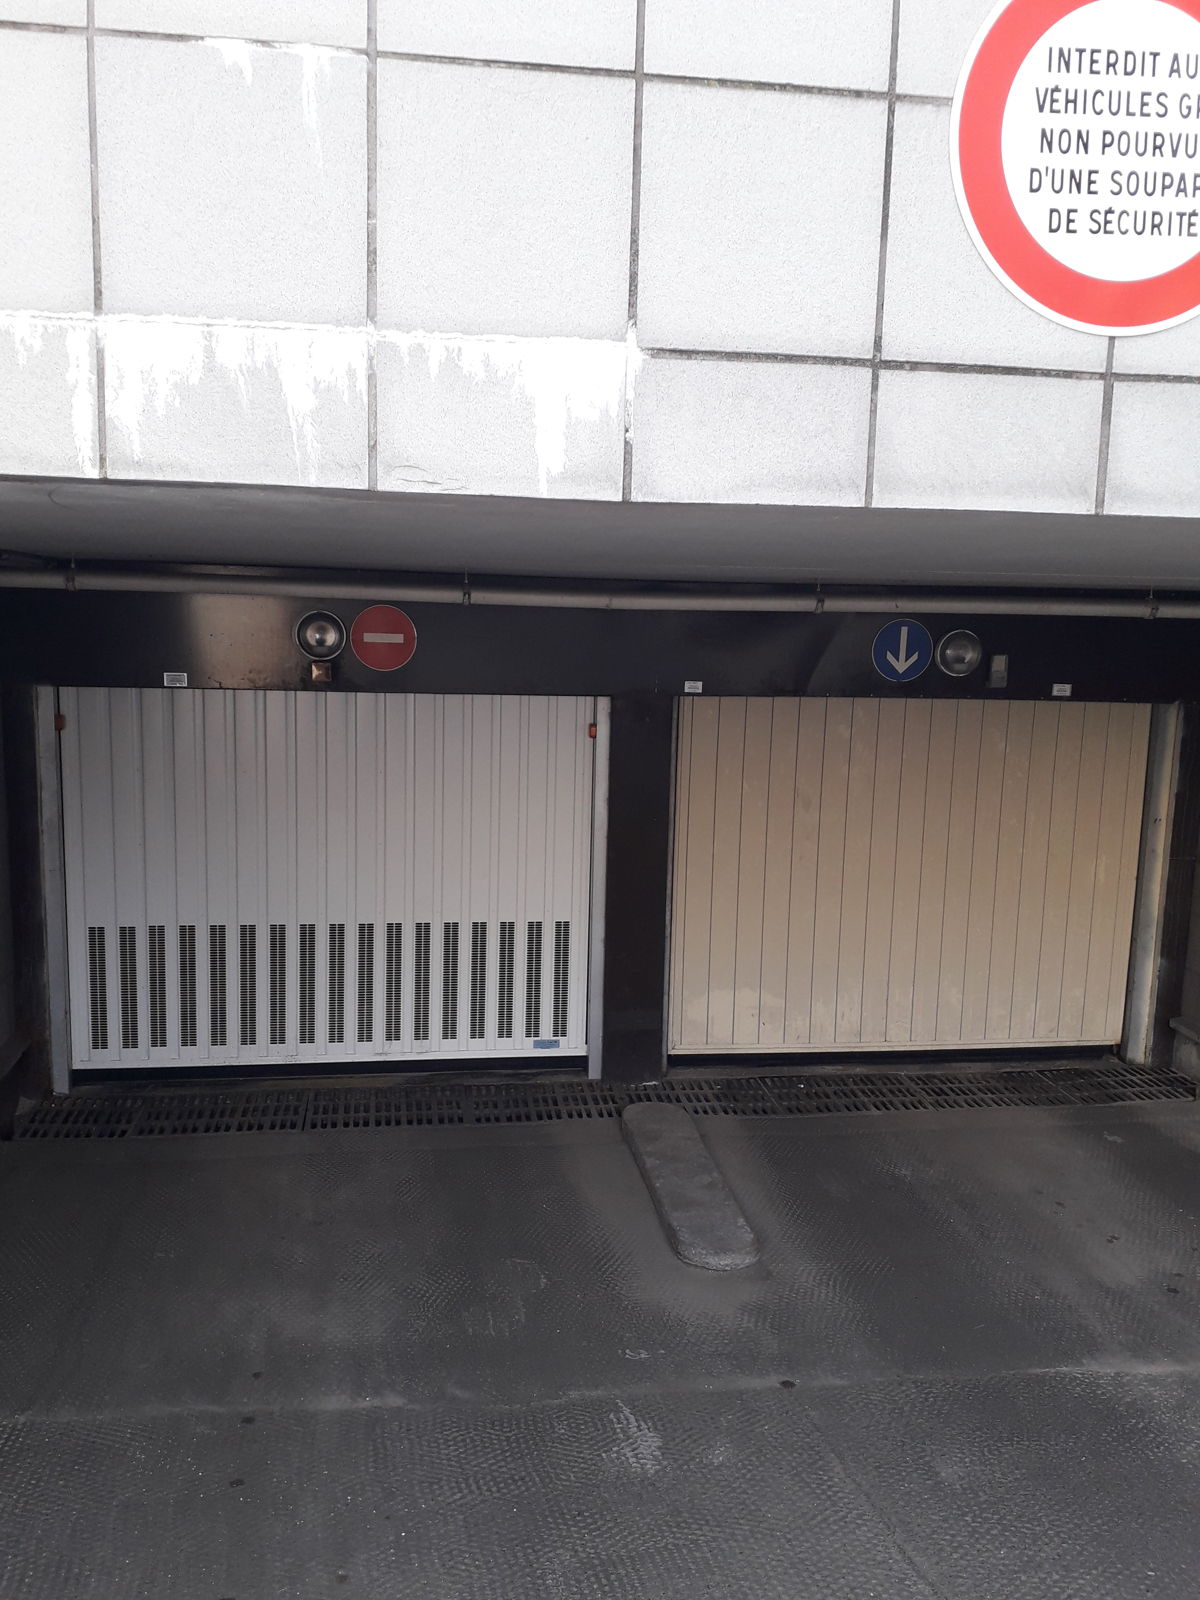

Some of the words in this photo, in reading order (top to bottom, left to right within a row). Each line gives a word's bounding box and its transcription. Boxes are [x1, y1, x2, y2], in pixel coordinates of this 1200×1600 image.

[1049, 47, 1160, 77] INTERDIT
[1036, 85, 1168, 118] VÉHICULES
[1041, 128, 1089, 154] NON
[1102, 130, 1197, 158] POURVU
[1030, 167, 1099, 194] D'UNE
[1049, 208, 1078, 233] DE
[1089, 207, 1198, 236] SÉCURITÉ
